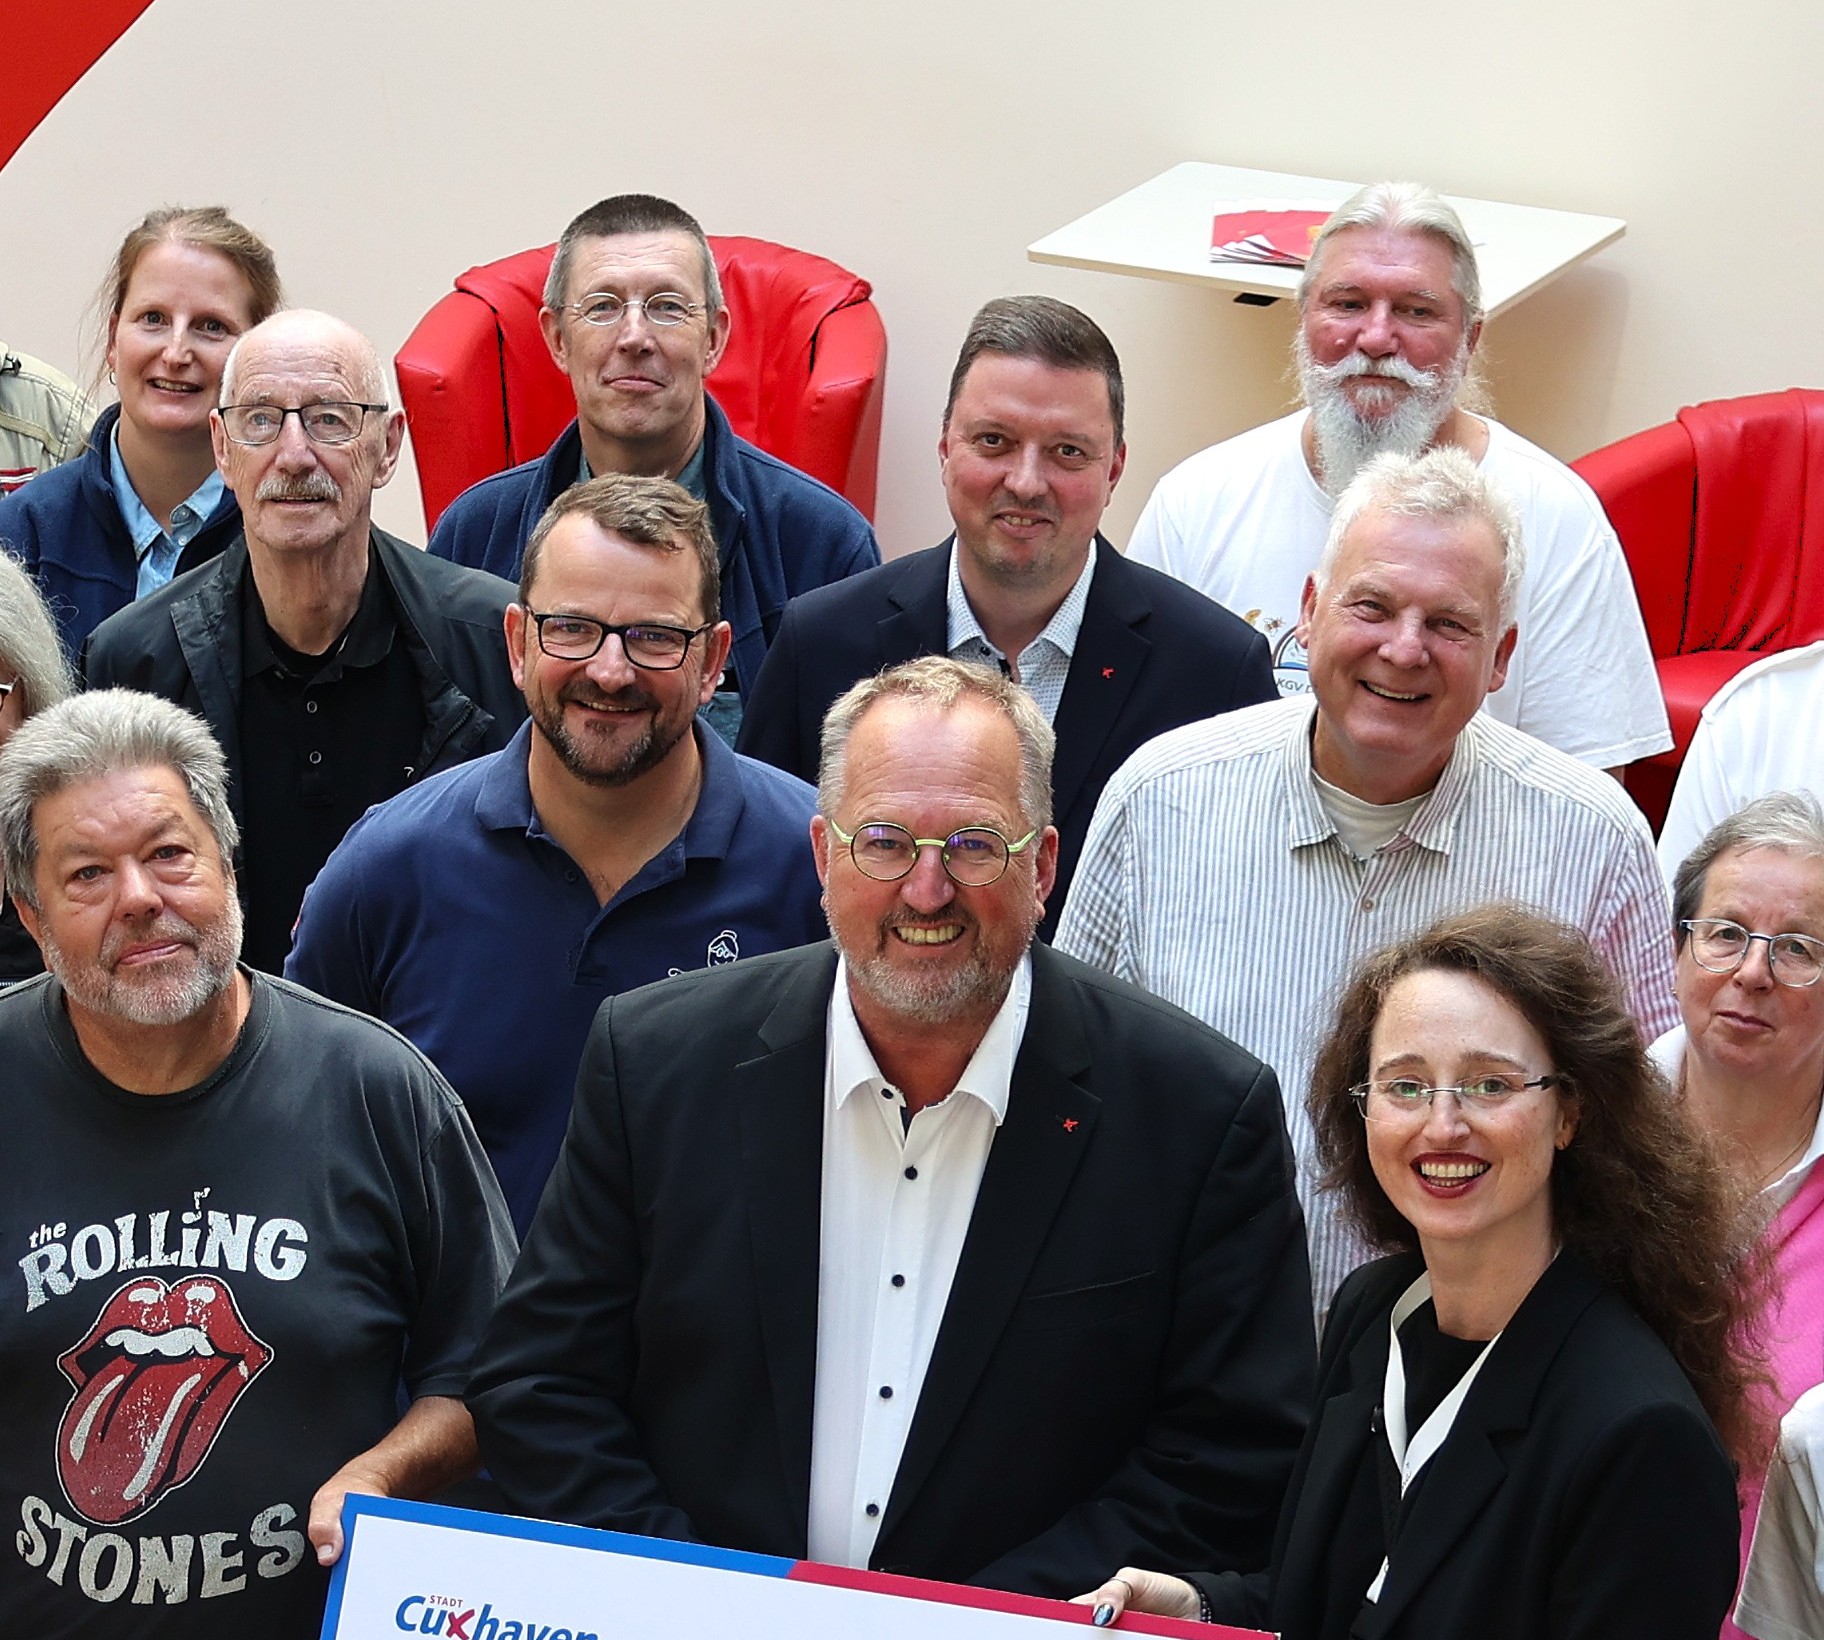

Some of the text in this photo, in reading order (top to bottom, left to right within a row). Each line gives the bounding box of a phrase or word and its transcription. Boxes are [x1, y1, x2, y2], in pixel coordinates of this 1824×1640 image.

[1276, 677, 1304, 691] KGV
[28, 1220, 67, 1249] the
[16, 1494, 306, 1606] STONES
[430, 1594, 464, 1608] STADT
